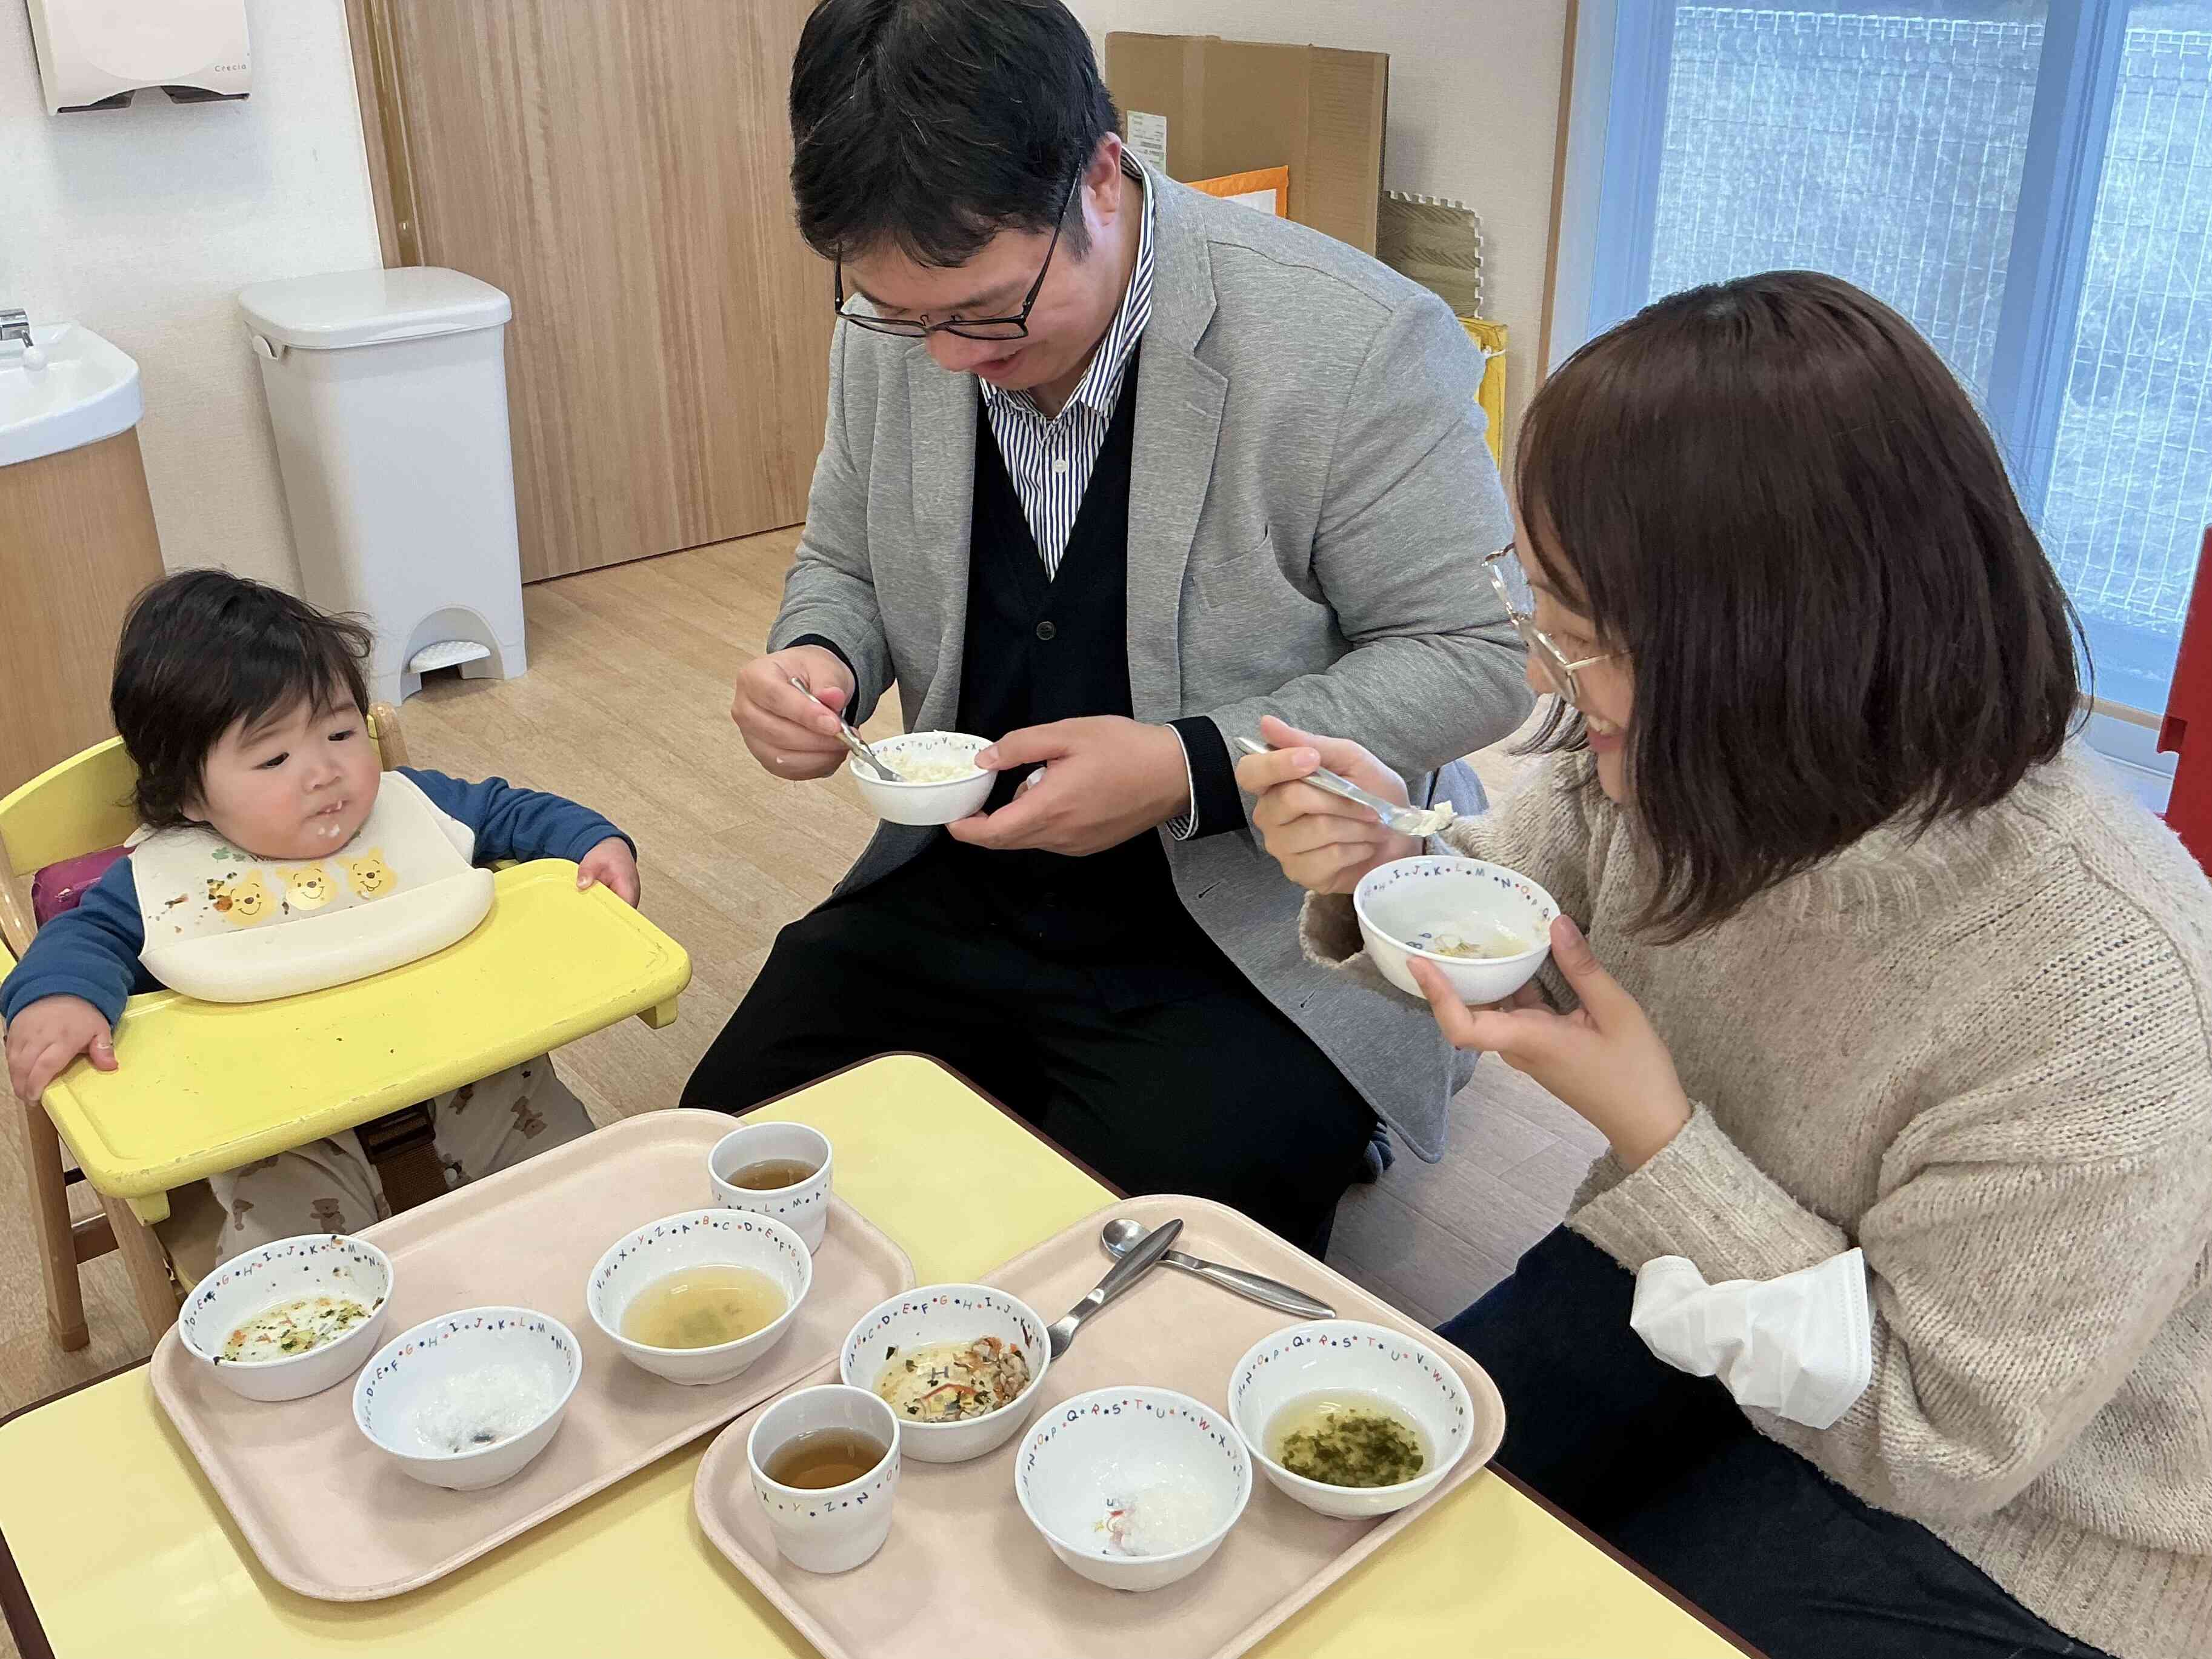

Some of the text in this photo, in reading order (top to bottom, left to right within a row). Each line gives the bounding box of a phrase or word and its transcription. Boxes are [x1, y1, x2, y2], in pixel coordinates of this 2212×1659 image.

[215, 64, 247, 72] Crecia
[744, 1222, 752, 1231] D
[310, 1245, 318, 1254] K
[902, 1303, 910, 1314] E
[921, 1303, 928, 1314] F
[962, 1300, 972, 1310] H
[428, 1337, 438, 1348] H
[474, 1317, 482, 1328] J
[498, 1320, 505, 1330] K
[1293, 1336, 1304, 1347] Q
[1319, 1334, 1328, 1346] R
[1342, 1337, 1351, 1348] S
[1367, 1337, 1376, 1346] T
[1391, 1350, 1400, 1361] U
[1417, 1352, 1424, 1364] V
[1067, 1409, 1079, 1421] Q
[1091, 1403, 1100, 1415] R
[1112, 1403, 1121, 1415] S
[1134, 1398, 1143, 1409] T
[1156, 1408, 1165, 1418] U
